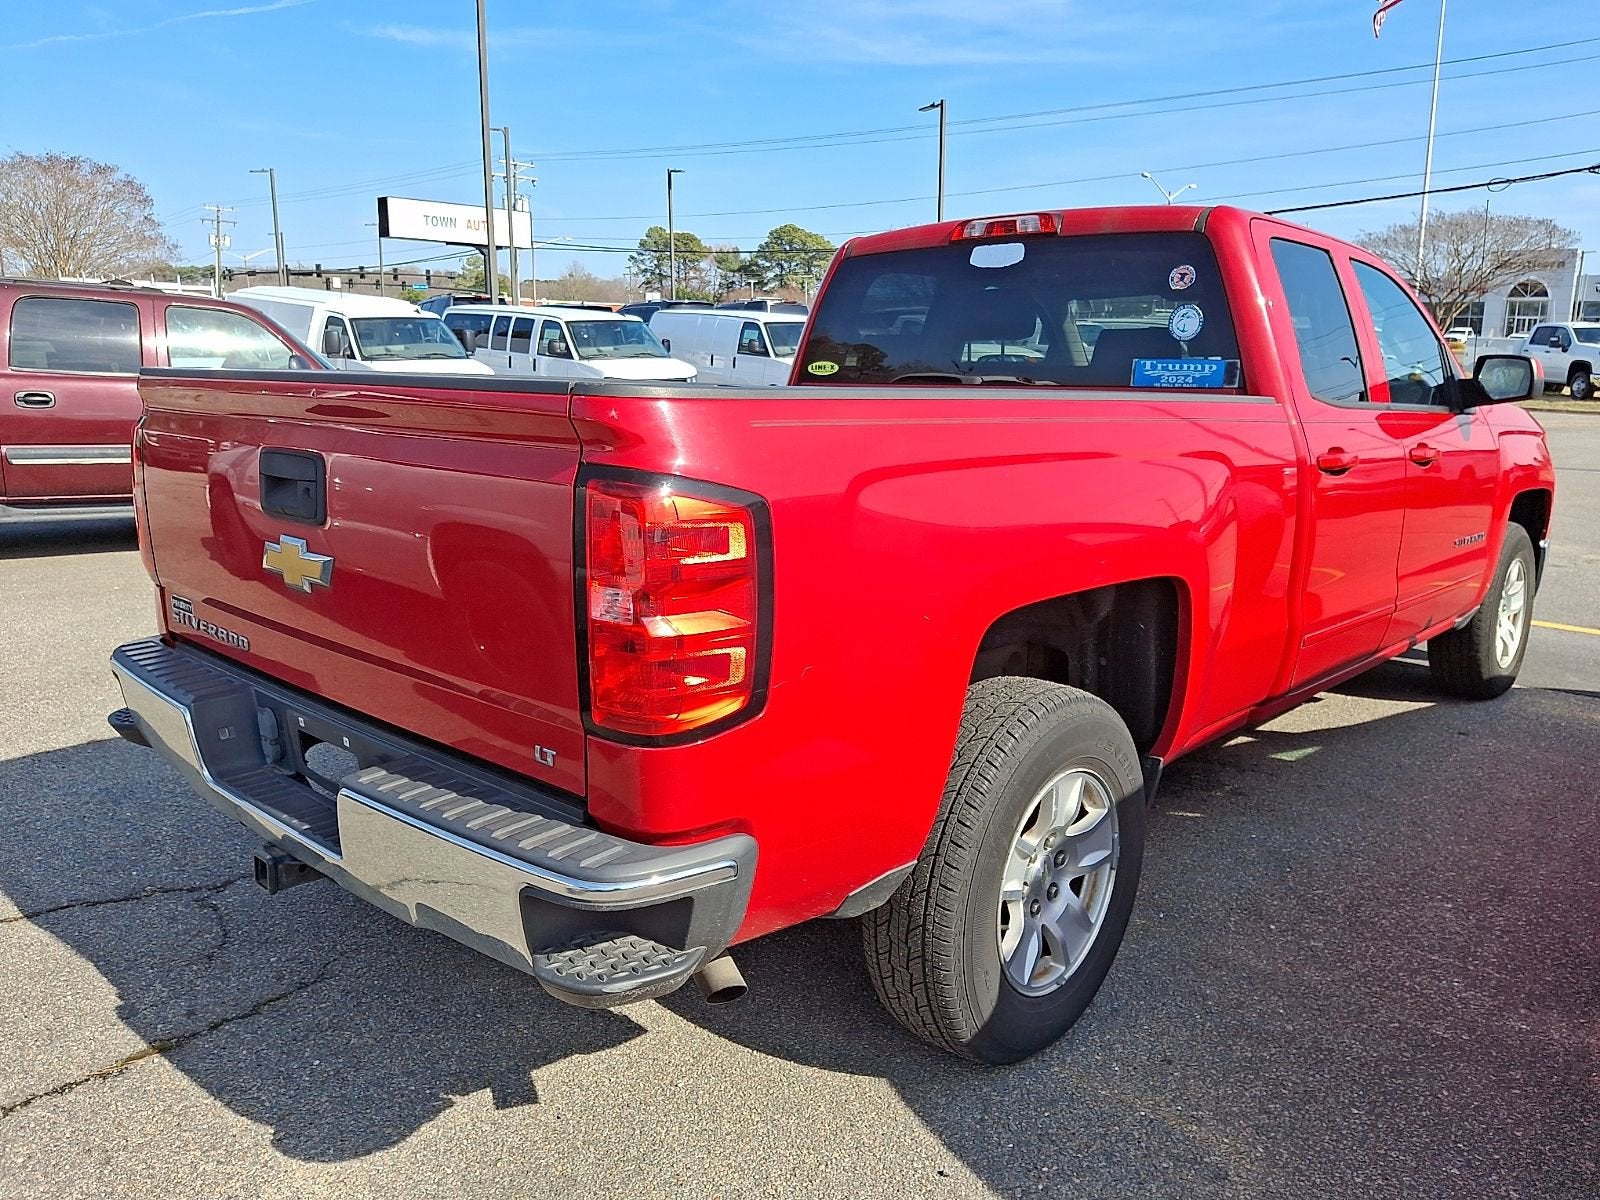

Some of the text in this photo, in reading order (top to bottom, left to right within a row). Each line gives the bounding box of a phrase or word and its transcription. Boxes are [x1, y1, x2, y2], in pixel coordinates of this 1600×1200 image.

[424, 215, 487, 231] TOWN AUT
[1141, 360, 1217, 374] Trump
[1160, 375, 1193, 383] 2024
[173, 611, 250, 652] SILVERADO
[535, 745, 556, 767] LT
